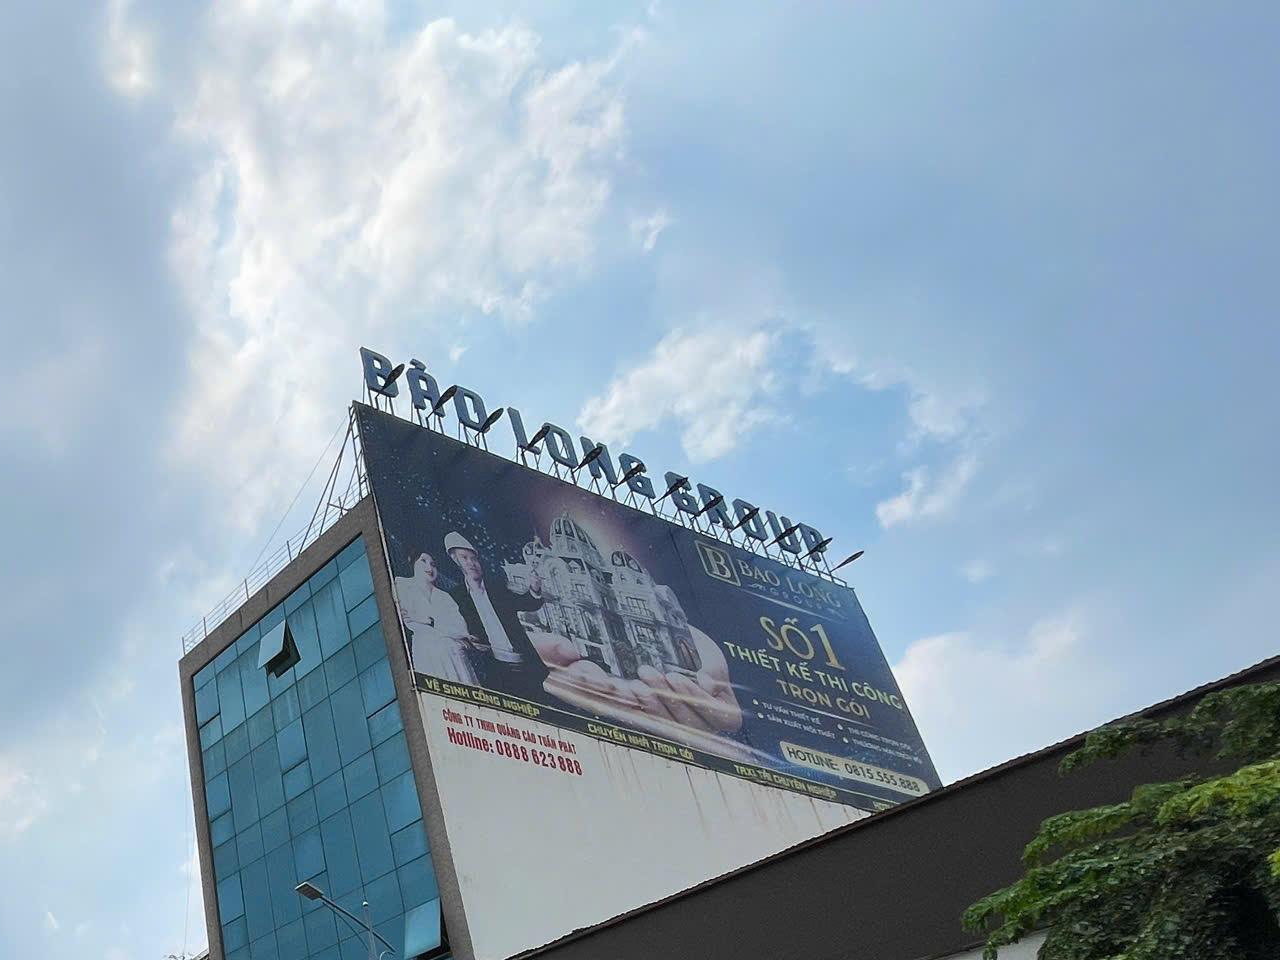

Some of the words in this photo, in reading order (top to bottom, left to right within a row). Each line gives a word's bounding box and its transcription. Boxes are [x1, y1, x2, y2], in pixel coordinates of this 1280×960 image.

[360, 346, 491, 433] BẢO
[507, 407, 656, 499] LONG
[664, 471, 829, 563] GROUP
[425, 678, 442, 692] VỆ
[443, 683, 470, 698] SINH
[472, 688, 501, 706] CÔNG
[503, 697, 540, 717] NGHIỆP
[724, 641, 781, 672] THIẾT
[786, 661, 814, 683] KẾ
[815, 670, 849, 693] THI
[852, 682, 904, 710] CÔNG
[776, 679, 831, 708] TRỌN
[836, 696, 871, 719] GÓI
[442, 708, 463, 725] CÔNG
[464, 714, 474, 728] TY
[497, 723, 521, 740] QUẢNG
[522, 729, 537, 744] CÁO
[538, 734, 557, 750] TUẤN
[558, 739, 577, 755] PHÁT
[447, 727, 494, 755] Hotline:
[495, 740, 529, 763] 0888
[531, 749, 557, 769] 623
[558, 755, 582, 776] 888
